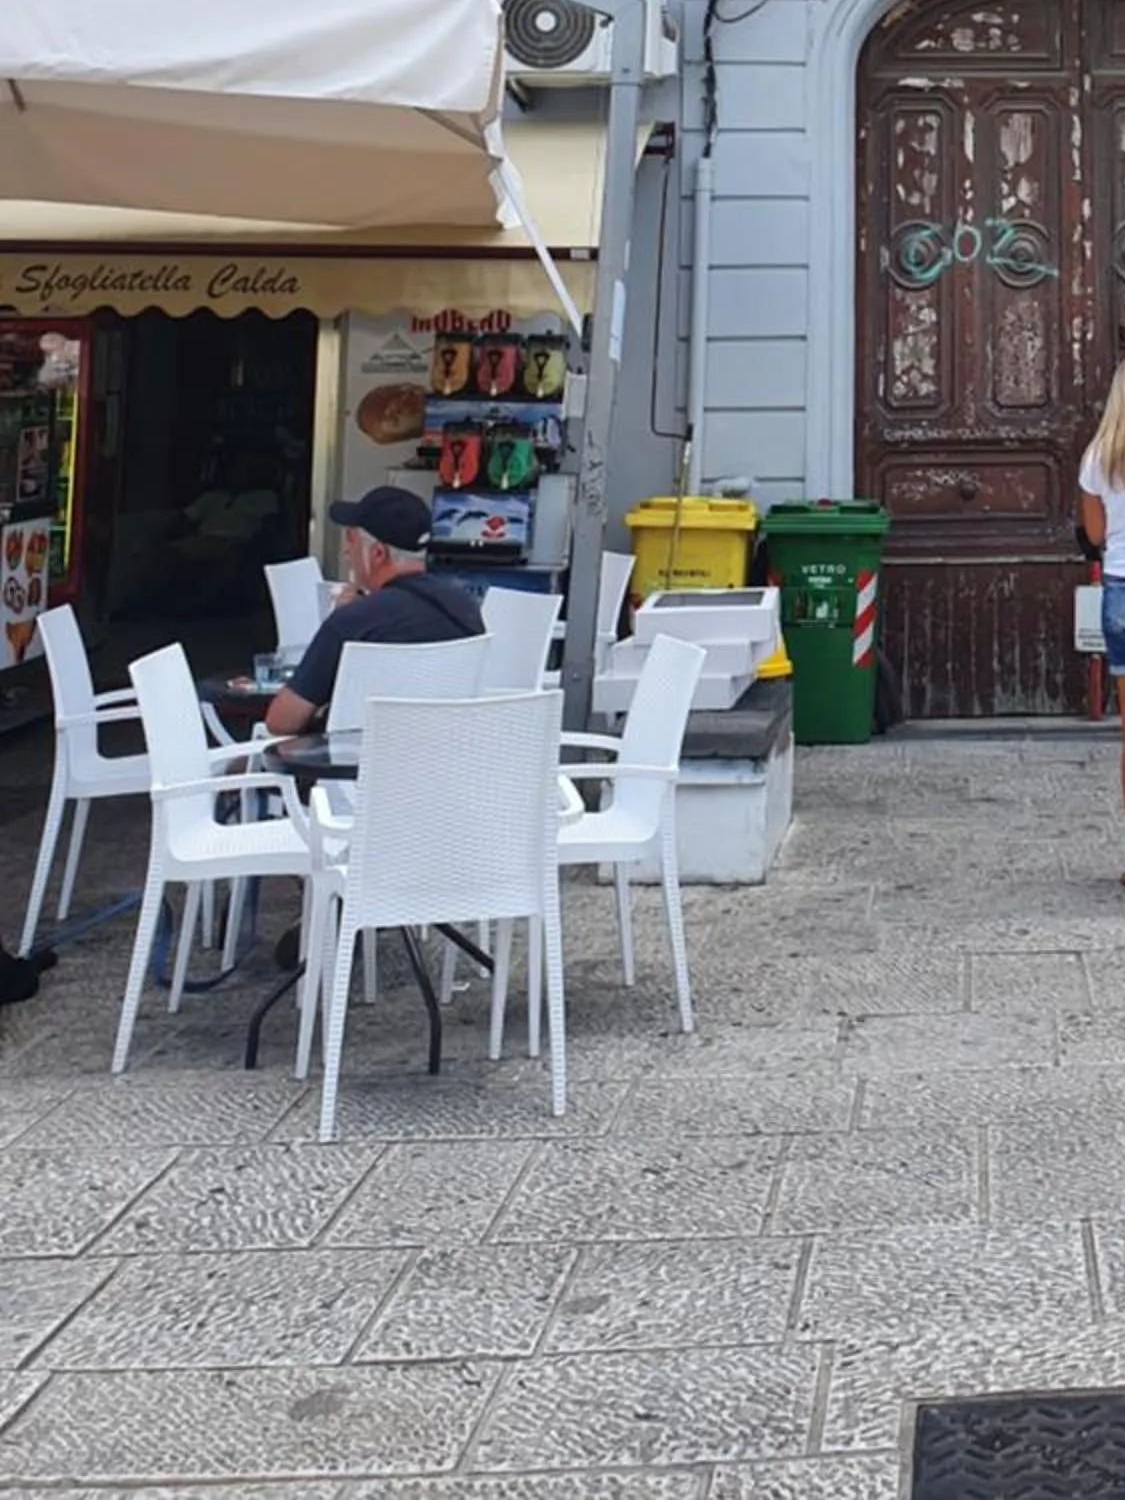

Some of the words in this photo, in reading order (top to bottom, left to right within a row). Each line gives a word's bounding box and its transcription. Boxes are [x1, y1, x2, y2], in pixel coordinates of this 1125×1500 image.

[15, 263, 193, 302] Sfogliatella
[207, 262, 301, 299] Calda
[802, 564, 846, 575] VETRO
